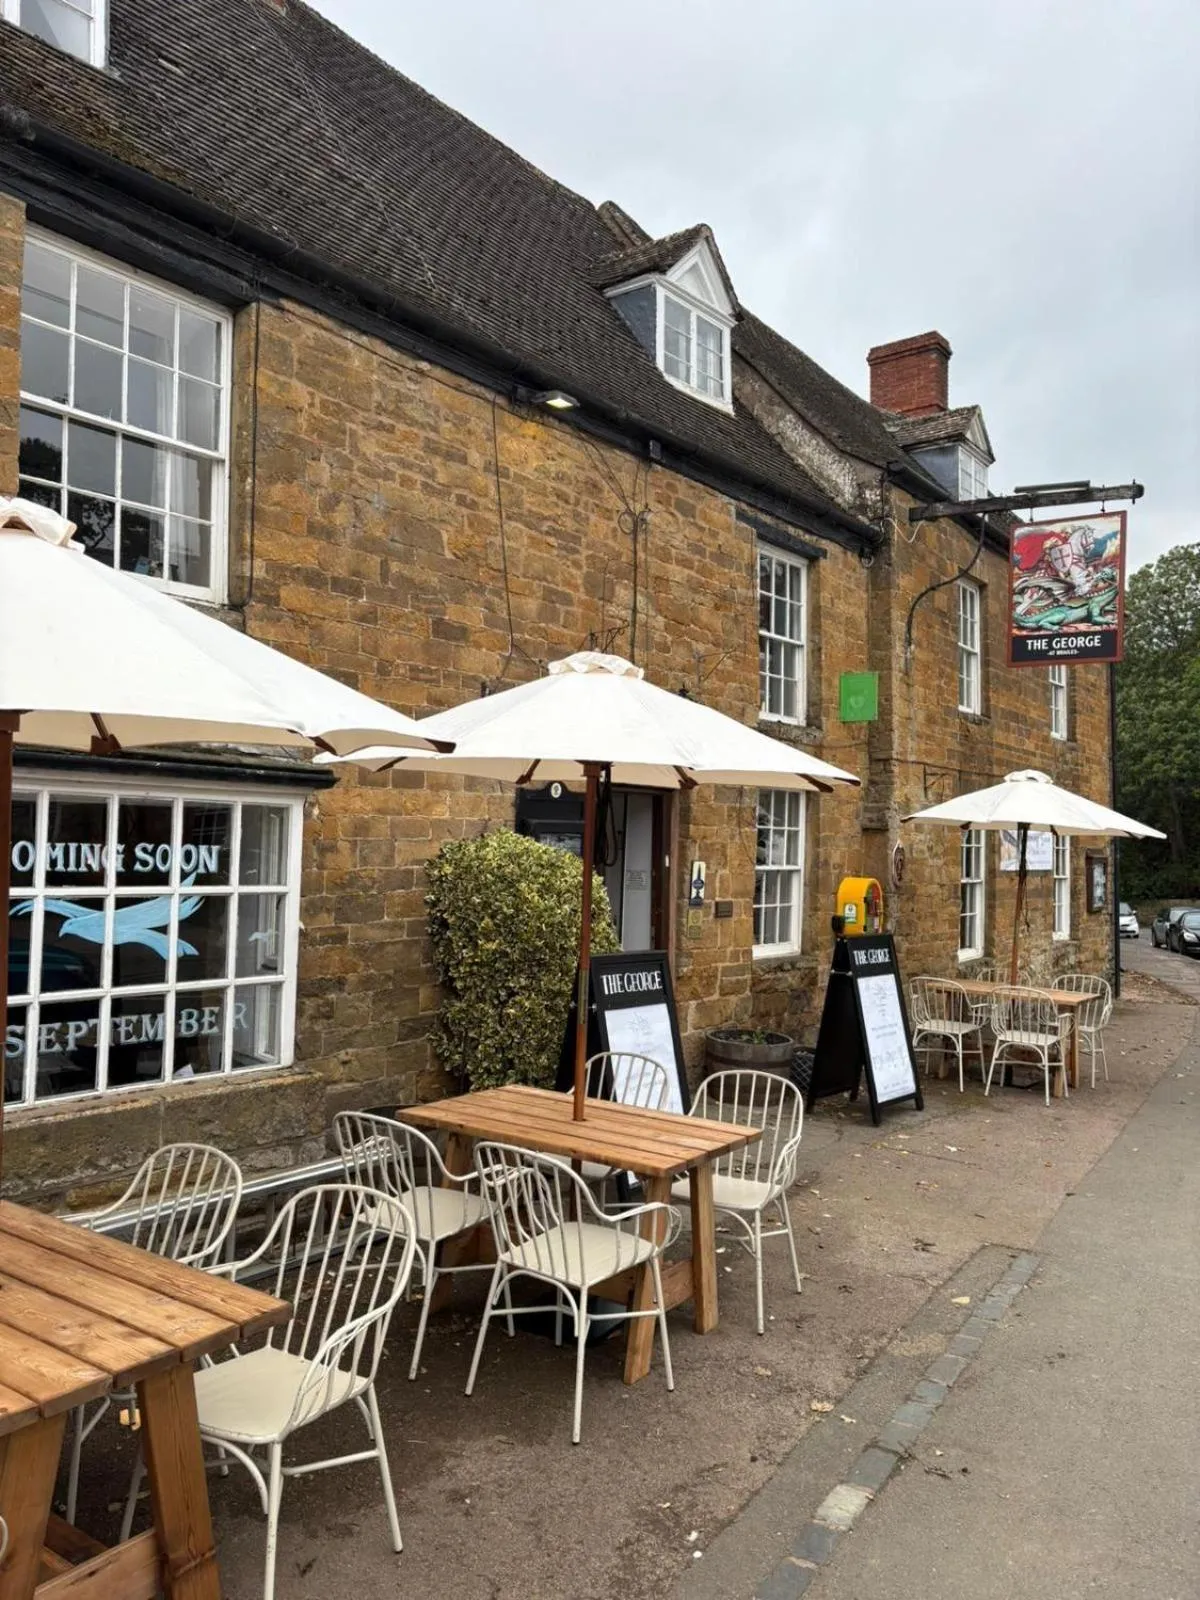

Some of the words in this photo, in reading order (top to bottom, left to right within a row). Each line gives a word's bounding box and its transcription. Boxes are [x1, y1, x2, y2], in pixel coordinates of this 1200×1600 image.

[1026, 638, 1049, 650] THE
[1052, 635, 1101, 649] GEORGE
[9, 840, 126, 873] OMING
[133, 842, 221, 874] SOON
[600, 973, 625, 995] THE
[623, 970, 663, 992] GEORGE
[5, 1002, 248, 1058] SEPTEMBER
